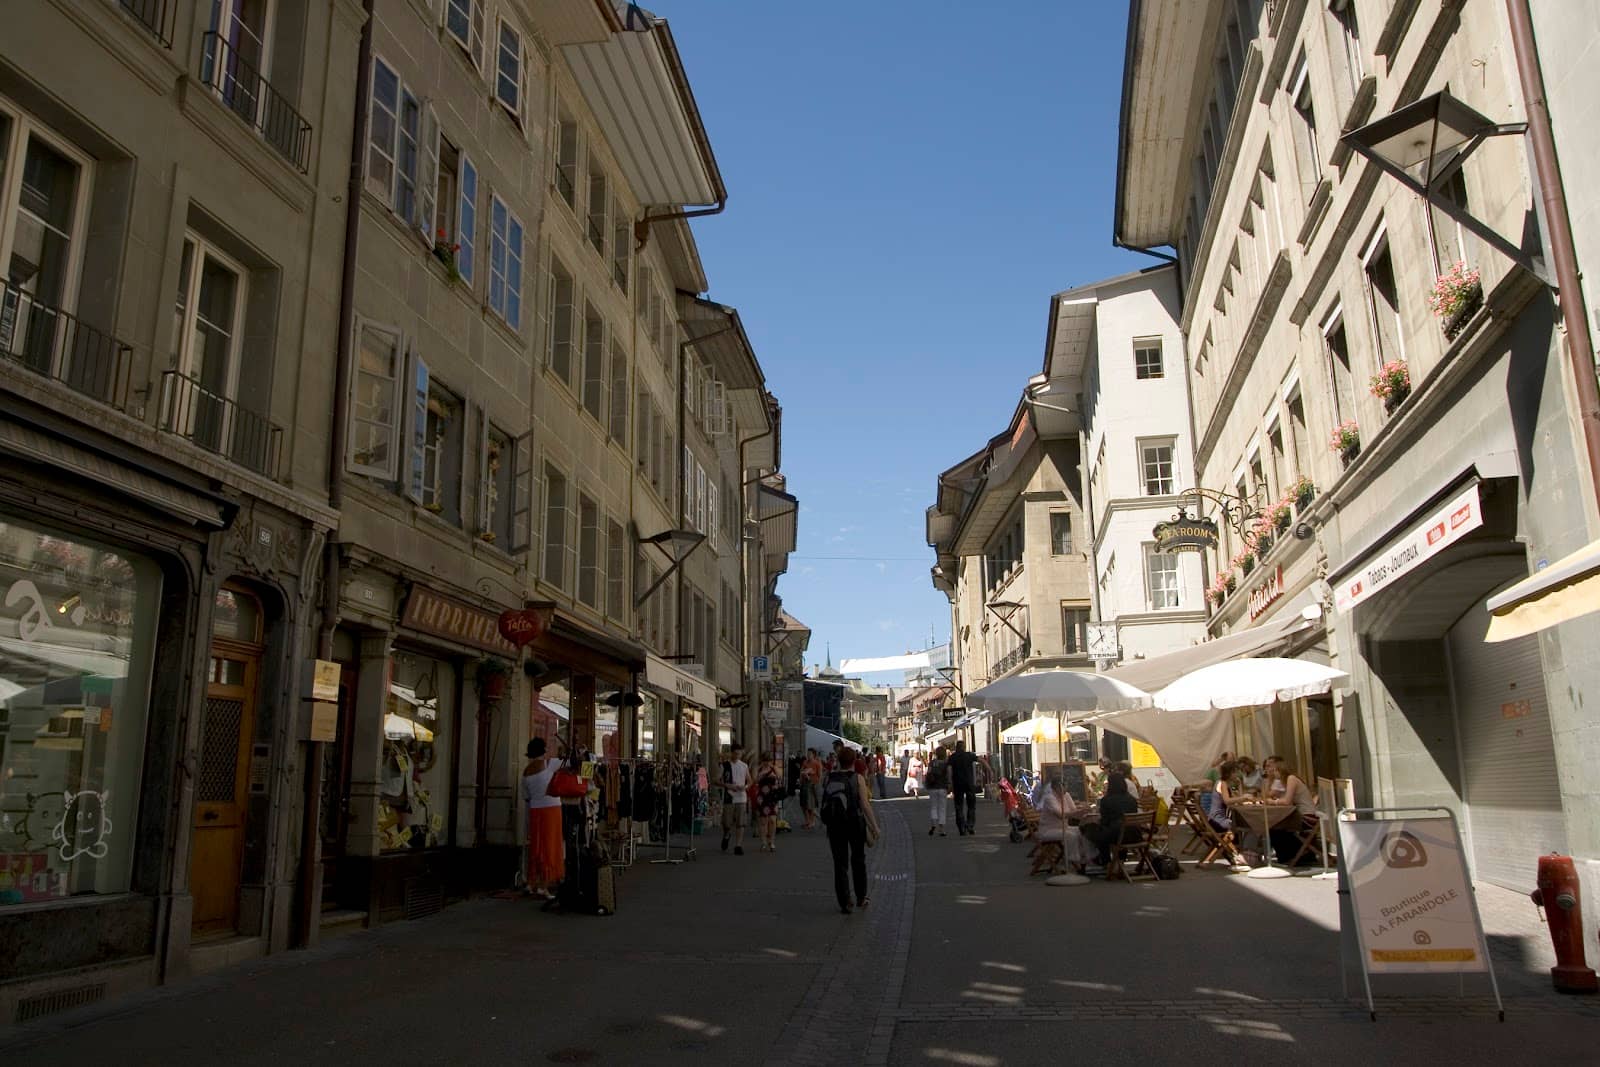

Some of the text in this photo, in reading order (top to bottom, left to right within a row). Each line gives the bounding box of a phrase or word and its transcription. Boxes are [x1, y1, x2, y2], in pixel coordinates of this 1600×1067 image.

[1368, 564, 1387, 586] Tabacs
[1391, 543, 1419, 572] Journaux
[1371, 888, 1458, 937] LA FARANDOLE
[1380, 889, 1430, 917] Boutique
